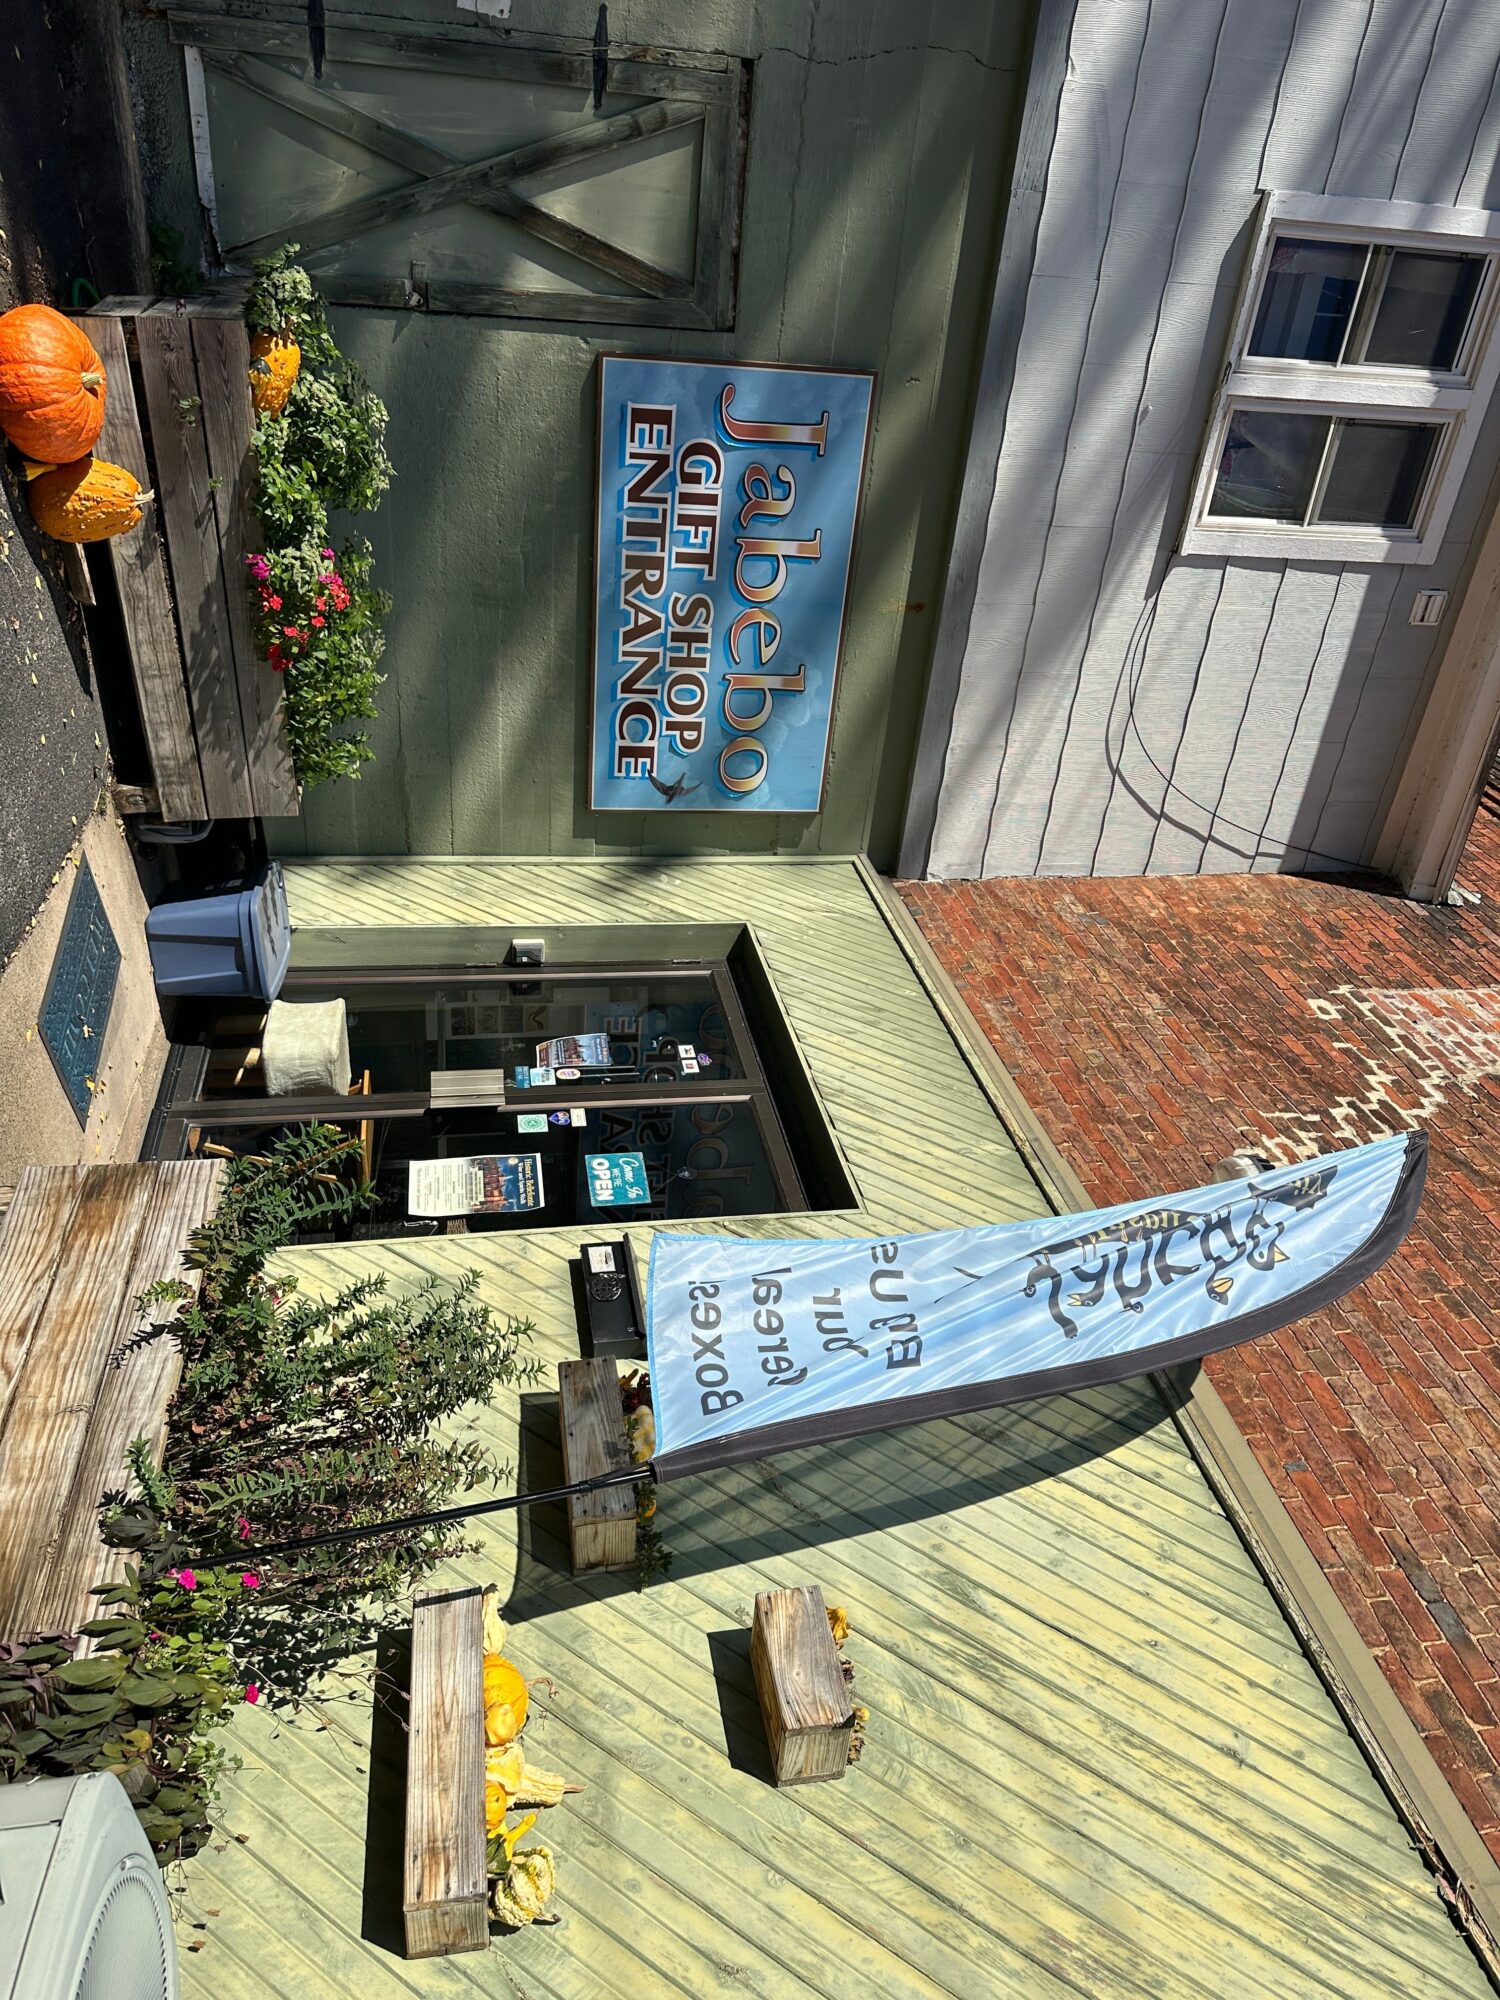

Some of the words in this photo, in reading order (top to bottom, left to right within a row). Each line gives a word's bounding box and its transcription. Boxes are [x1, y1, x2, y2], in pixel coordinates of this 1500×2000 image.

[670, 439, 725, 581] GIFT
[613, 400, 677, 779] ENTRANCE
[718, 383, 830, 794] Jabebo
[661, 592, 715, 754] SHOP
[523, 1158, 534, 1180] Historic
[591, 1157, 615, 1202] OPEN
[611, 1167, 623, 1188] WE'RE
[618, 1157, 640, 1184] Come
[625, 1184, 644, 1200] In
